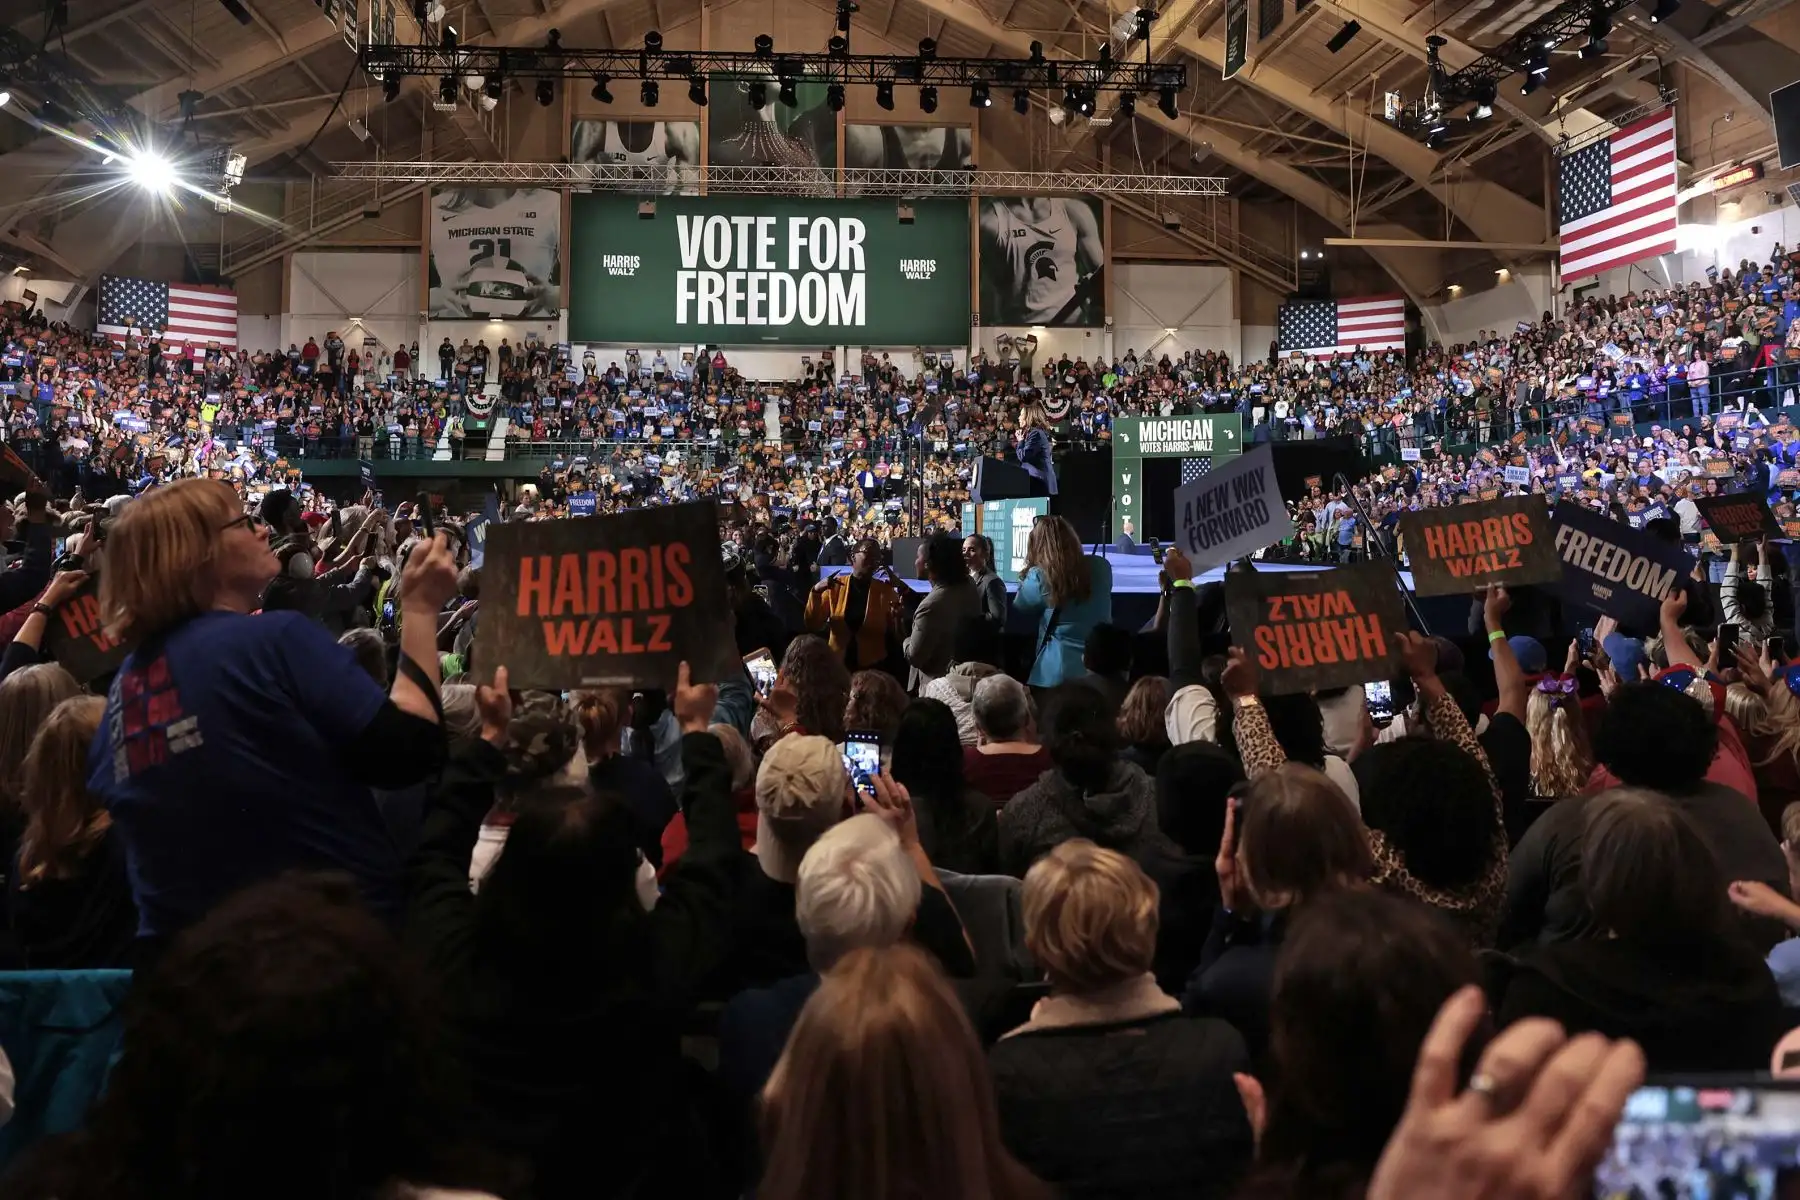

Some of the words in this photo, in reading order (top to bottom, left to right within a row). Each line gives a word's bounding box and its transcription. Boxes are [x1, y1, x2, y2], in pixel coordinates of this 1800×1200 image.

[448, 227, 500, 240] MICHIGAN
[503, 226, 534, 236] STATE
[676, 215, 776, 270] VOTE
[788, 216, 866, 271] FOR
[469, 238, 510, 267] 21
[603, 254, 640, 268] HARRIS
[900, 259, 936, 272] HARRIS
[608, 268, 634, 276] WALZ
[905, 272, 931, 280] WALZ
[676, 270, 866, 326] FREEDOM
[1140, 418, 1214, 442] MICHIGAN
[1140, 442, 1162, 453] VOTES
[1162, 440, 1214, 452] HARRIS-WALZ
[1183, 502, 1193, 529] A
[1196, 480, 1229, 522] NEW
[1232, 466, 1266, 504] WAY
[1188, 498, 1270, 554] FORWARD
[1424, 512, 1533, 560] HARRIS
[1445, 548, 1523, 578] WALZ
[1554, 524, 1678, 602] FREEDOM
[516, 542, 694, 617] HARRIS
[1266, 590, 1357, 621] WALZ
[542, 614, 672, 656] WALZ
[1254, 614, 1387, 670] HARRIS
